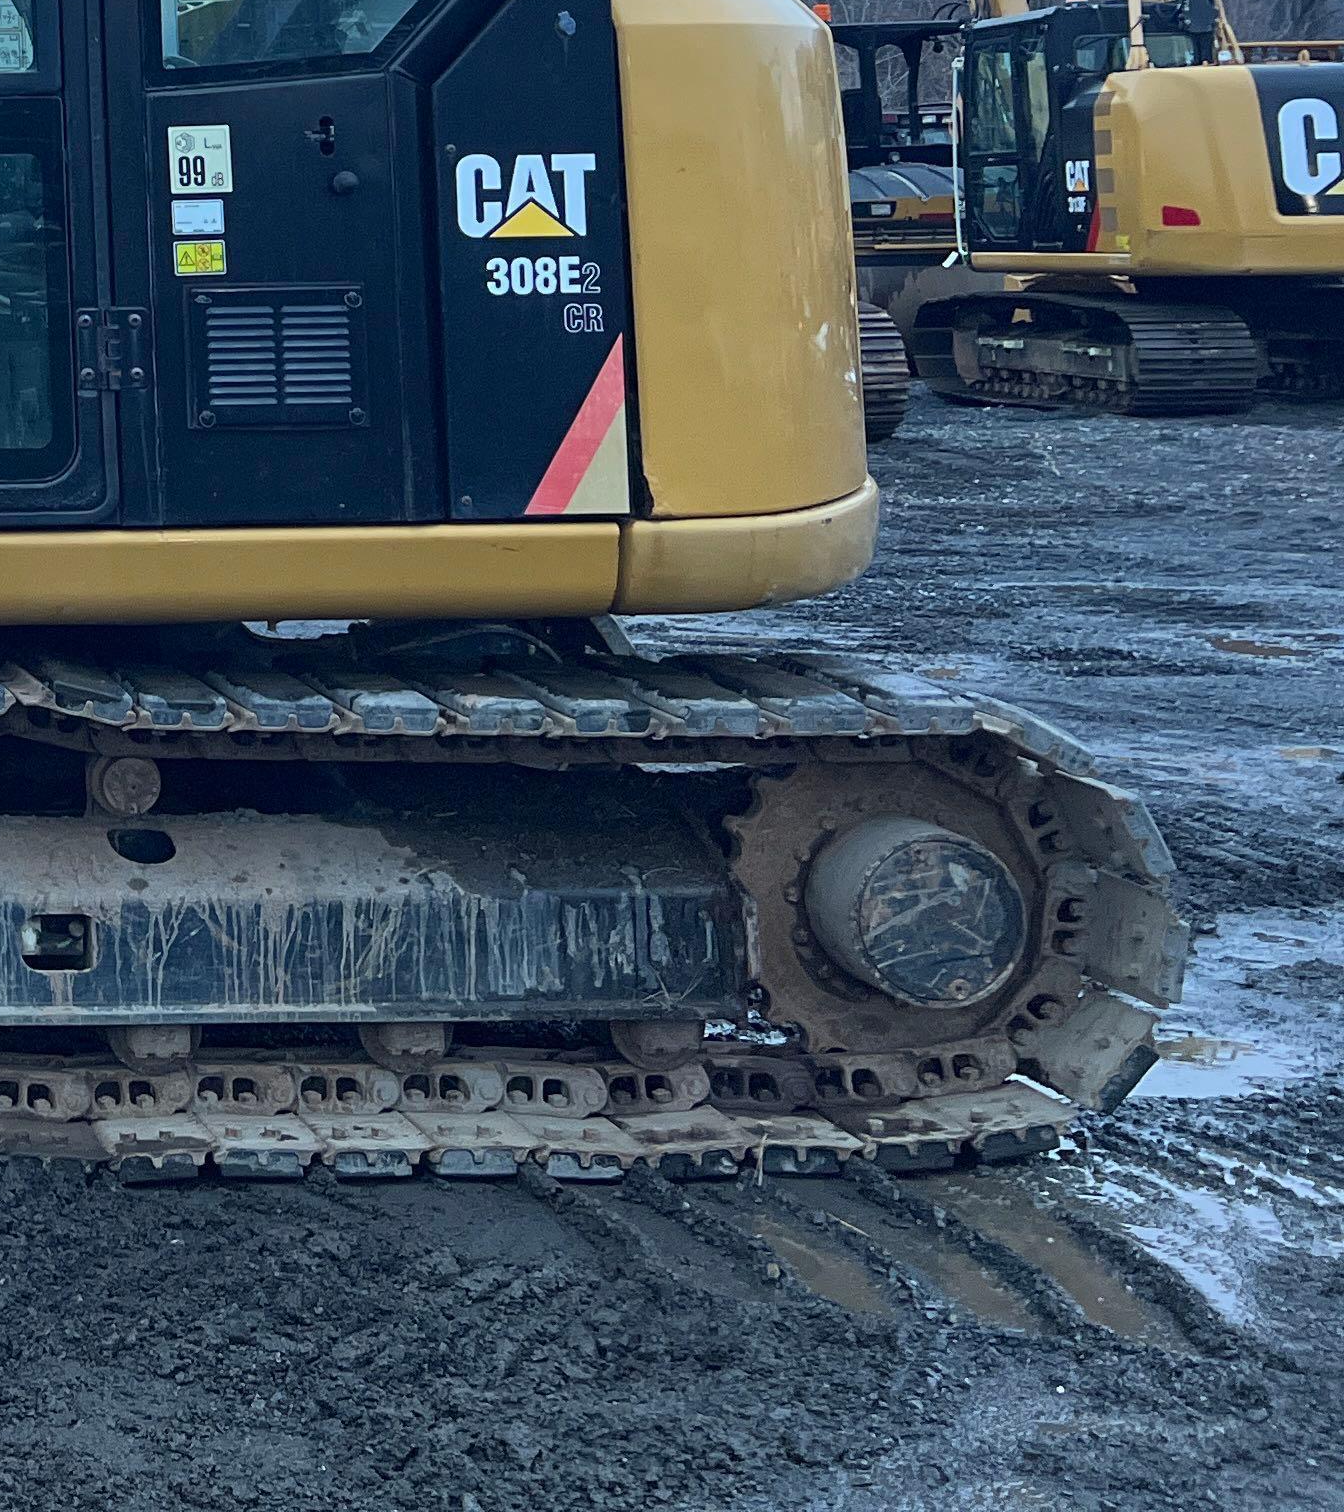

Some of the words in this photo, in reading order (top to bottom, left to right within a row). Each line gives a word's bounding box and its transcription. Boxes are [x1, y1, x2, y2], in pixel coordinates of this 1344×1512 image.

[178, 155, 206, 187] 99
[211, 171, 226, 187] dB
[1065, 160, 1090, 192] CAT
[455, 152, 597, 239] CAT
[485, 255, 602, 296] 308E2
[563, 302, 605, 334] CR
